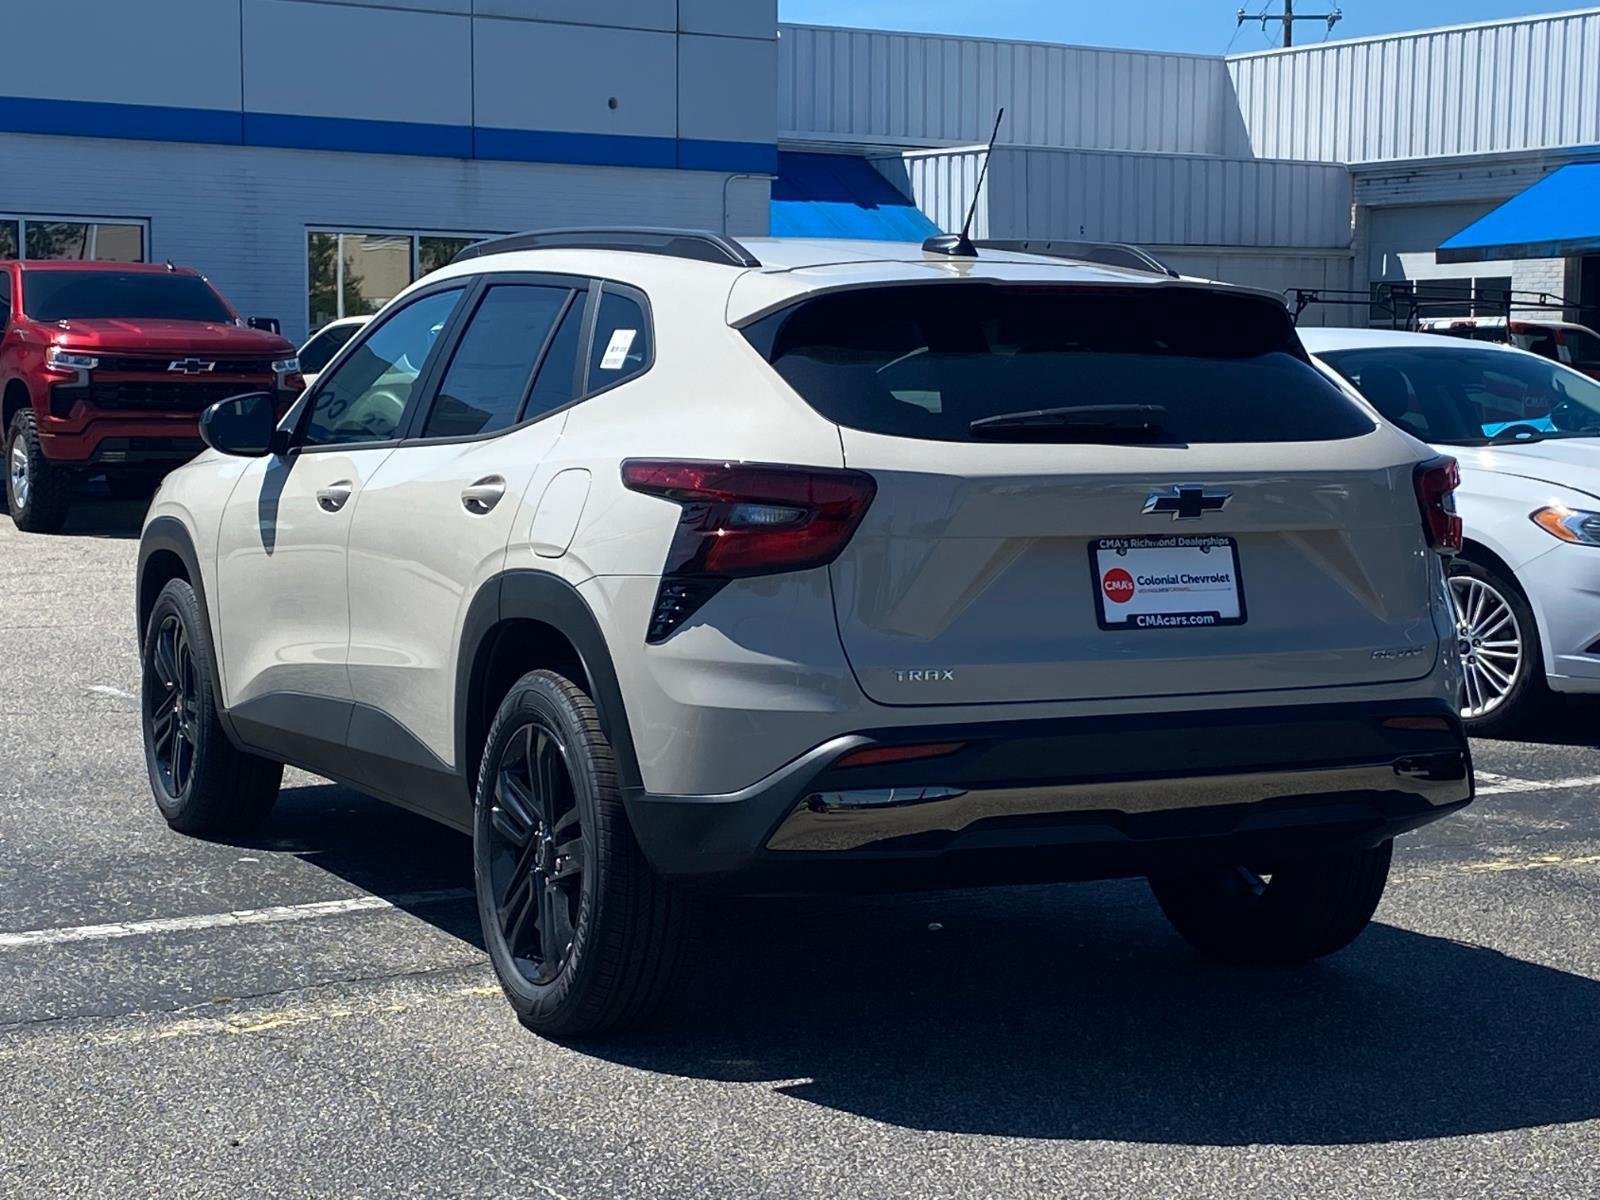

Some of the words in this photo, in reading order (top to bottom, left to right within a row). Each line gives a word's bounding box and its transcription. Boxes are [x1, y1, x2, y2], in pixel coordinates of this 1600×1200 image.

[1099, 539, 1128, 548] CMA's
[1130, 536, 1176, 547] Richmond
[1178, 535, 1229, 546] Dealerships
[1136, 574, 1180, 586] Colonial
[1180, 572, 1231, 584] Chevrolet
[1104, 580, 1133, 591] CMA's
[1136, 615, 1215, 626] CMAcars.com
[896, 670, 954, 681] TRAX
